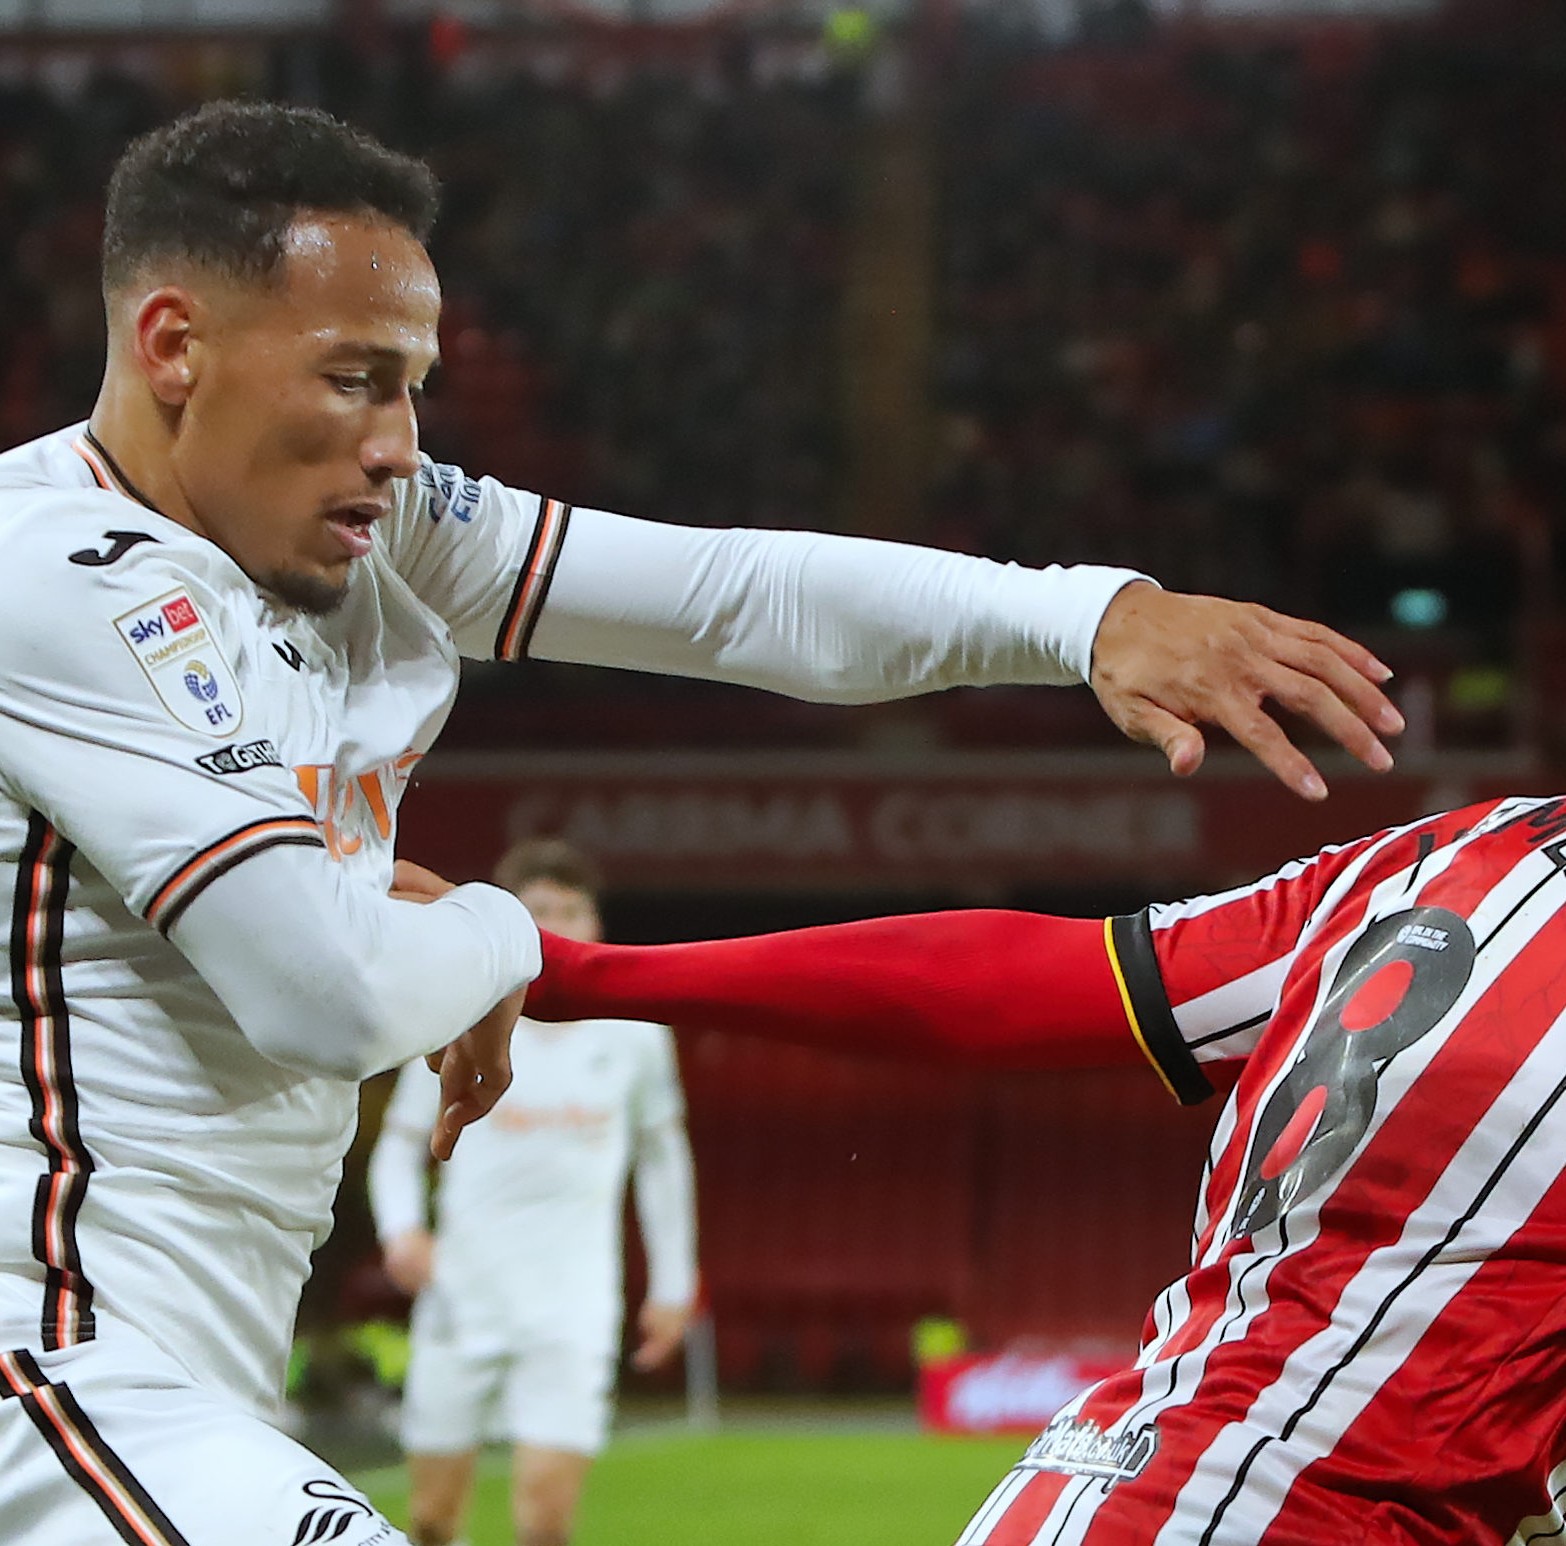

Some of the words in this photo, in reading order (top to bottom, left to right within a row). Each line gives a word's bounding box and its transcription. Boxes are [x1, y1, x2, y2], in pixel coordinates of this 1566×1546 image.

[129, 615, 165, 644] sky
[165, 601, 194, 624] bet
[204, 702, 233, 726] EFL
[199, 741, 280, 775] TOGETH
[1232, 907, 1476, 1240] 8
